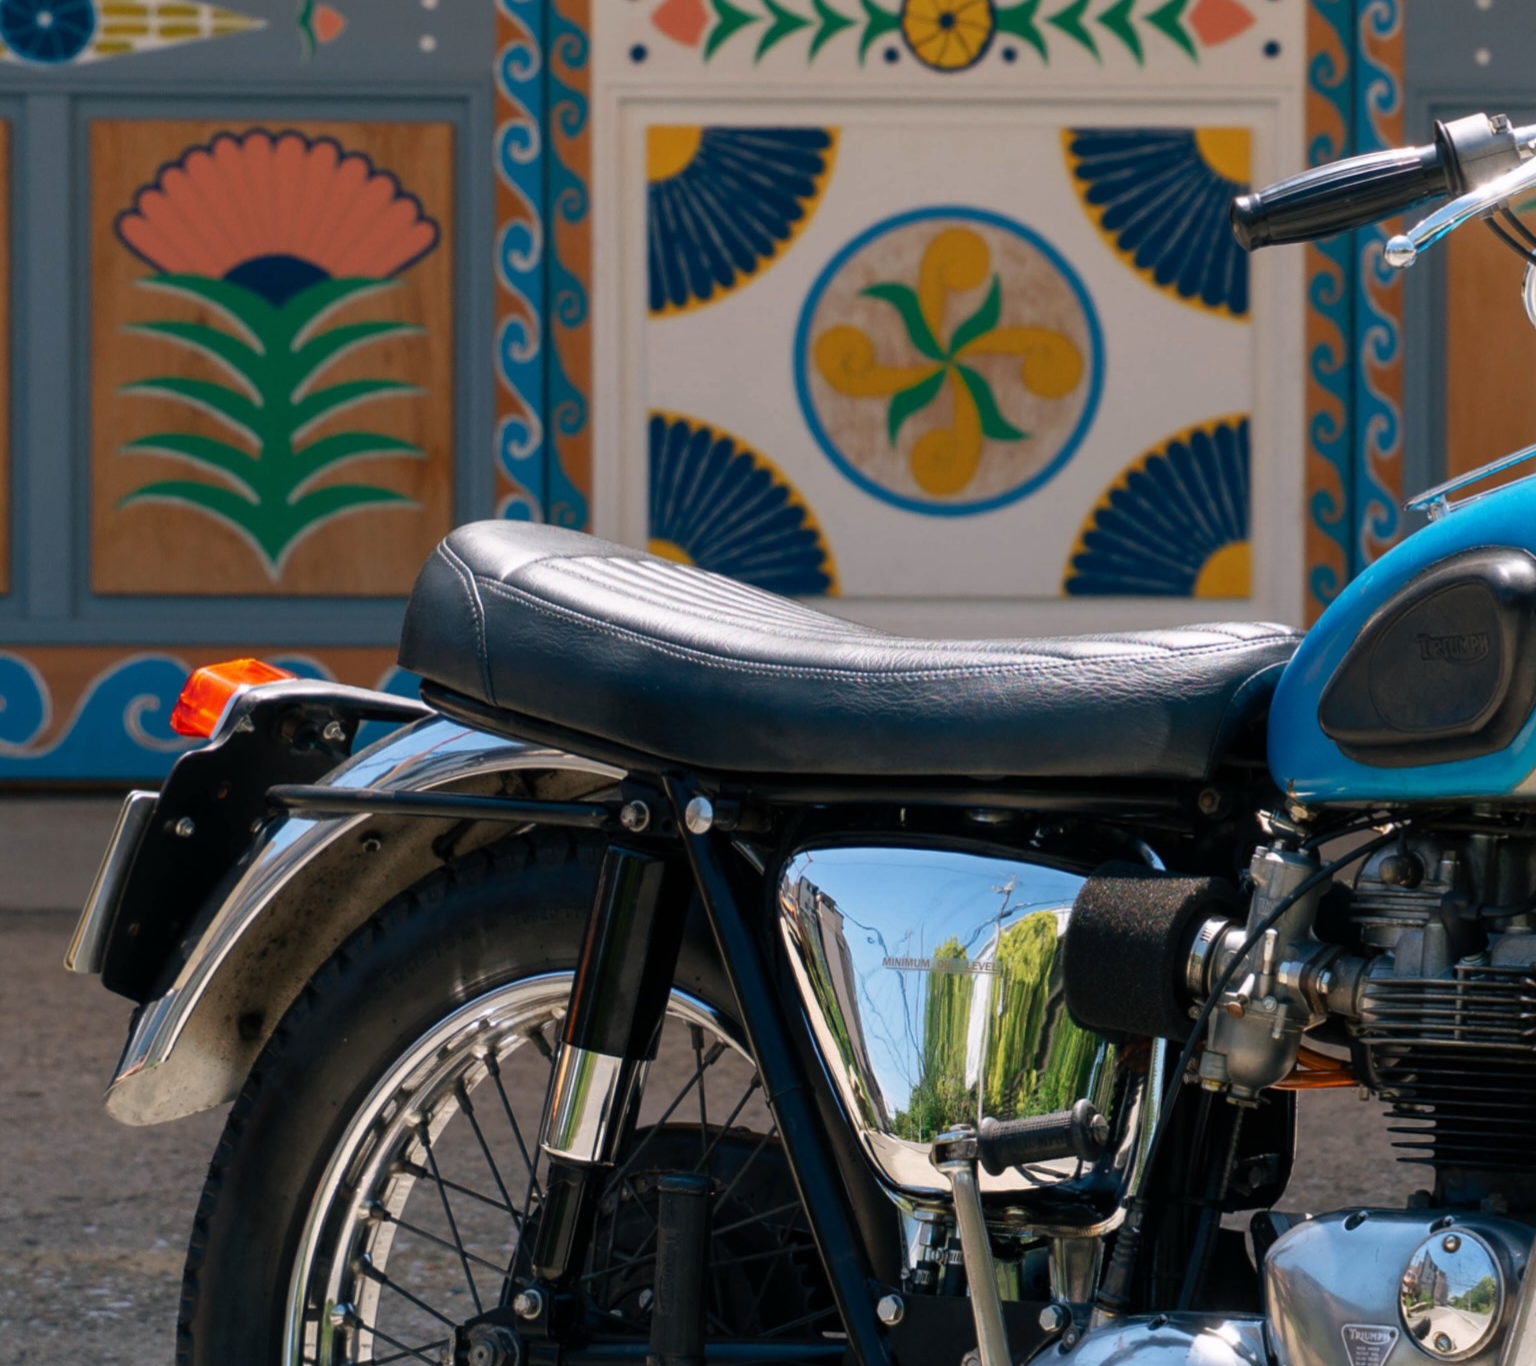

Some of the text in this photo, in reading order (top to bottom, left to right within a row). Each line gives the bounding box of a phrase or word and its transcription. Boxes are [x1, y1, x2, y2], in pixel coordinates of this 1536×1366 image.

[1414, 632, 1489, 664] TRIUMPH
[882, 957, 930, 969] MINIMUM
[966, 961, 998, 972] LEVEL
